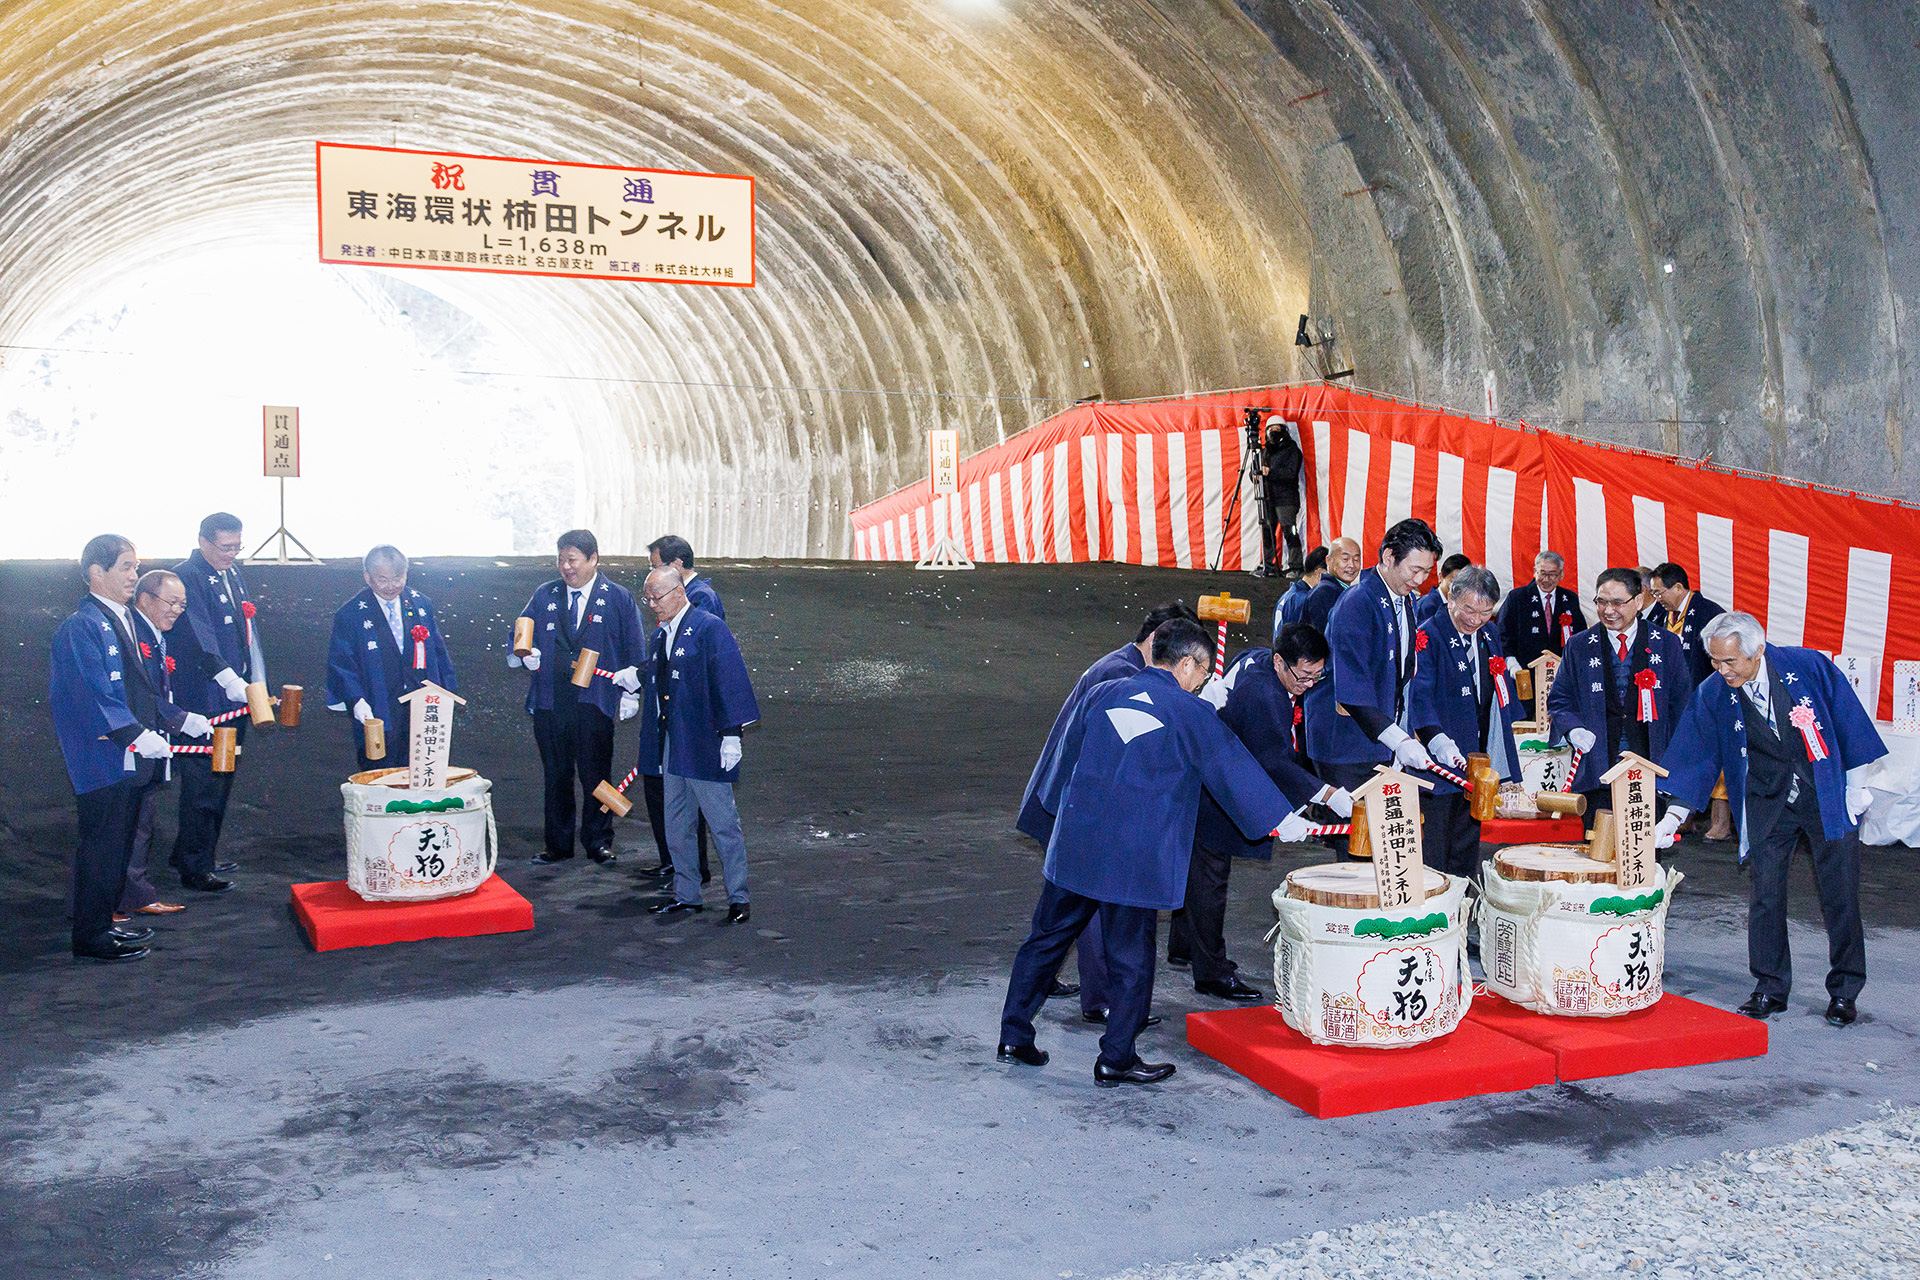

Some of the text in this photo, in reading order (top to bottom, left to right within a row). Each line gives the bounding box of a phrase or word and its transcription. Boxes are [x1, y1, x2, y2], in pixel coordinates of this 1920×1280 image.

[347, 190, 726, 242] 東海環状柿田トンネル
[535, 256, 594, 270] 名古屋支社
[274, 414, 290, 468] 貫通点
[939, 439, 952, 485] 貫通点
[1449, 637, 1472, 697] 大林組
[1588, 633, 1604, 693] 大林組
[415, 828, 445, 878] 天狗
[1392, 955, 1428, 1021] 天狗
[1624, 931, 1650, 991] 天狗
